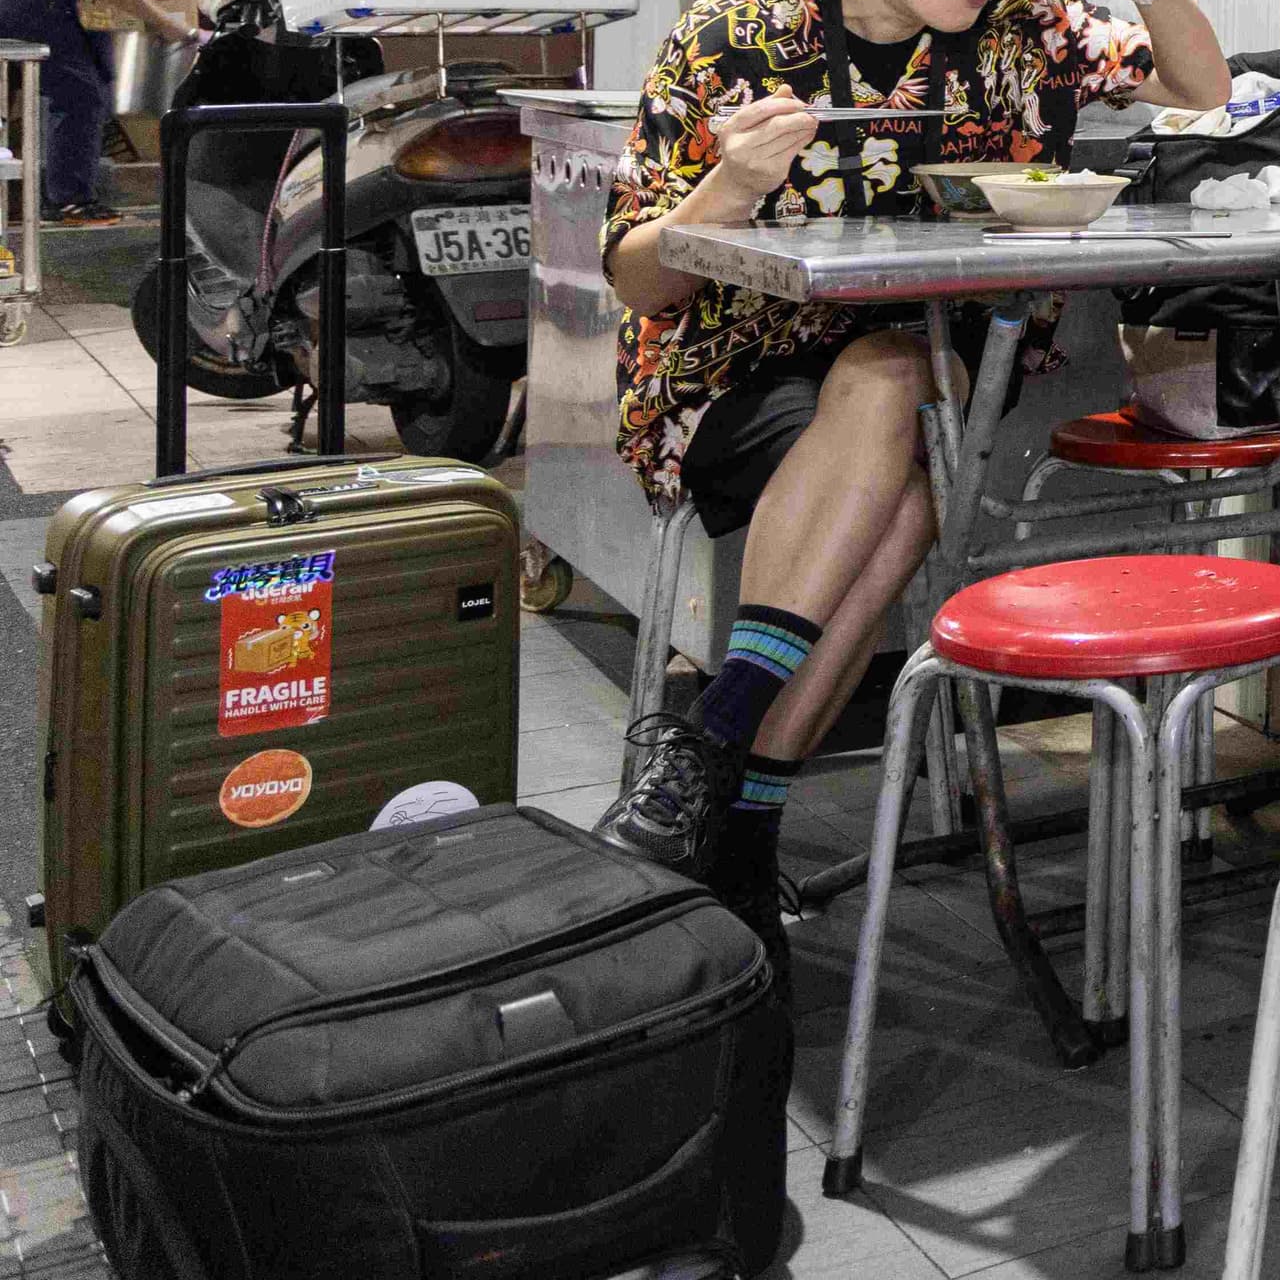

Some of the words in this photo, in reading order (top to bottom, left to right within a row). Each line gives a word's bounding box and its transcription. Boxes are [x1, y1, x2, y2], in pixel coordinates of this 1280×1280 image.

[870, 119, 922, 134] KAUAI
[425, 227, 531, 263] J5A-36
[462, 597, 491, 608] LOJEL
[225, 676, 327, 708] FRAGILE
[224, 705, 268, 718] HANDLE
[269, 701, 297, 712] WITH
[299, 695, 326, 706] CARE
